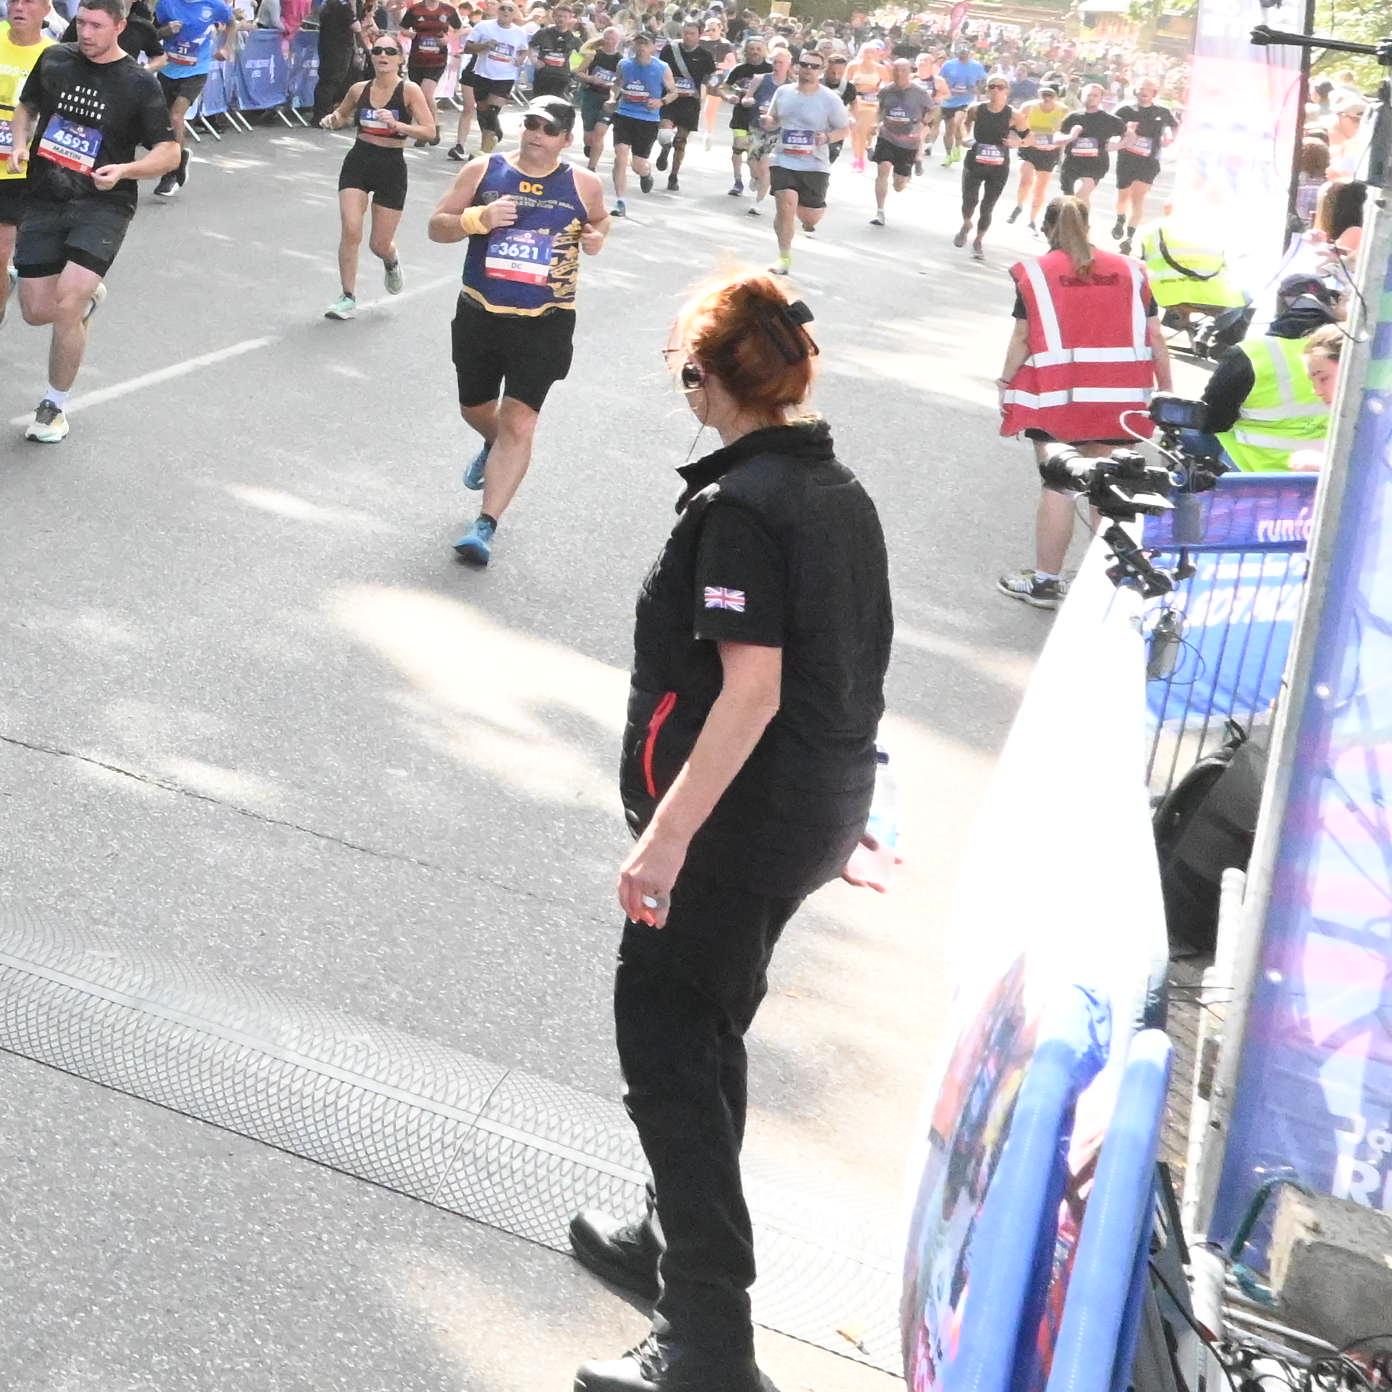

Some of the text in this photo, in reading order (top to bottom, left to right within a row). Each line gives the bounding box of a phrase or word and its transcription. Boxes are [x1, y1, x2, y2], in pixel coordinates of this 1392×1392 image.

[53, 129, 90, 153] 4593
[519, 181, 544, 196] DC
[498, 242, 539, 260] 3621
